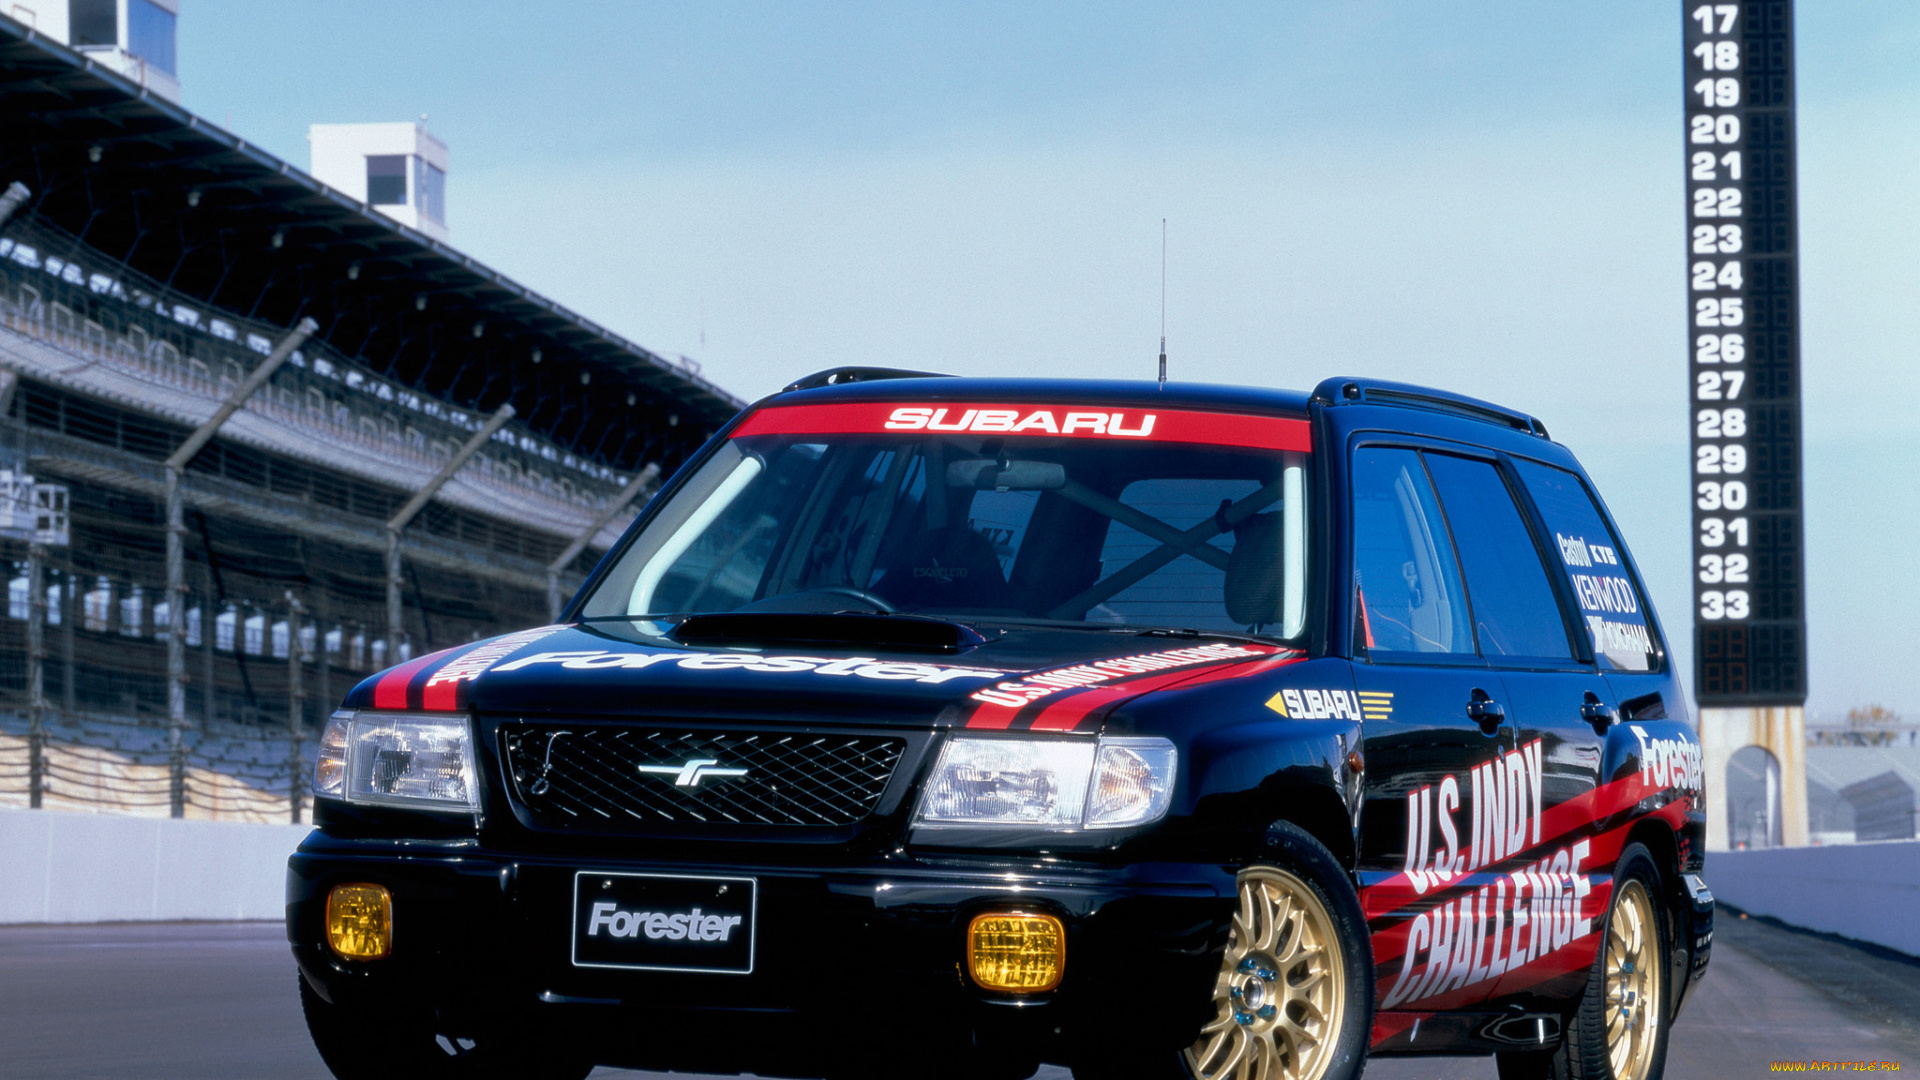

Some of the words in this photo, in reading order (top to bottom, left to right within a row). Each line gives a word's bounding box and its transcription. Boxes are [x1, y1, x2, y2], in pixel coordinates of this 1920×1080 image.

[1692, 4, 1739, 35] 17
[1693, 40, 1740, 71] 18
[1693, 77, 1740, 108] 19
[1691, 114, 1741, 144] 20
[1691, 150, 1742, 181] 21
[1693, 187, 1743, 218] 22
[1692, 224, 1743, 254] 23
[1692, 260, 1744, 291] 24
[1695, 297, 1745, 327] 25
[1696, 333, 1745, 364] 26
[1697, 370, 1746, 400] 27
[884, 408, 1157, 437] SUBARU
[1697, 407, 1747, 438] 28
[1696, 444, 1747, 474] 29
[1697, 480, 1748, 511] 30
[1700, 517, 1749, 548] 31
[1556, 532, 1592, 567] Castrol
[1589, 544, 1618, 565] KYB
[1699, 553, 1749, 584] 32
[1572, 574, 1637, 614] KENWOOD
[1700, 589, 1750, 620] 33
[489, 650, 1005, 684] Forester
[1093, 643, 1265, 673] CHALLENGE
[1282, 689, 1362, 721] SUBARU
[1630, 725, 1703, 790] Forester
[588, 902, 742, 941] Forester
[1381, 836, 1592, 1011] CHALLENGE
